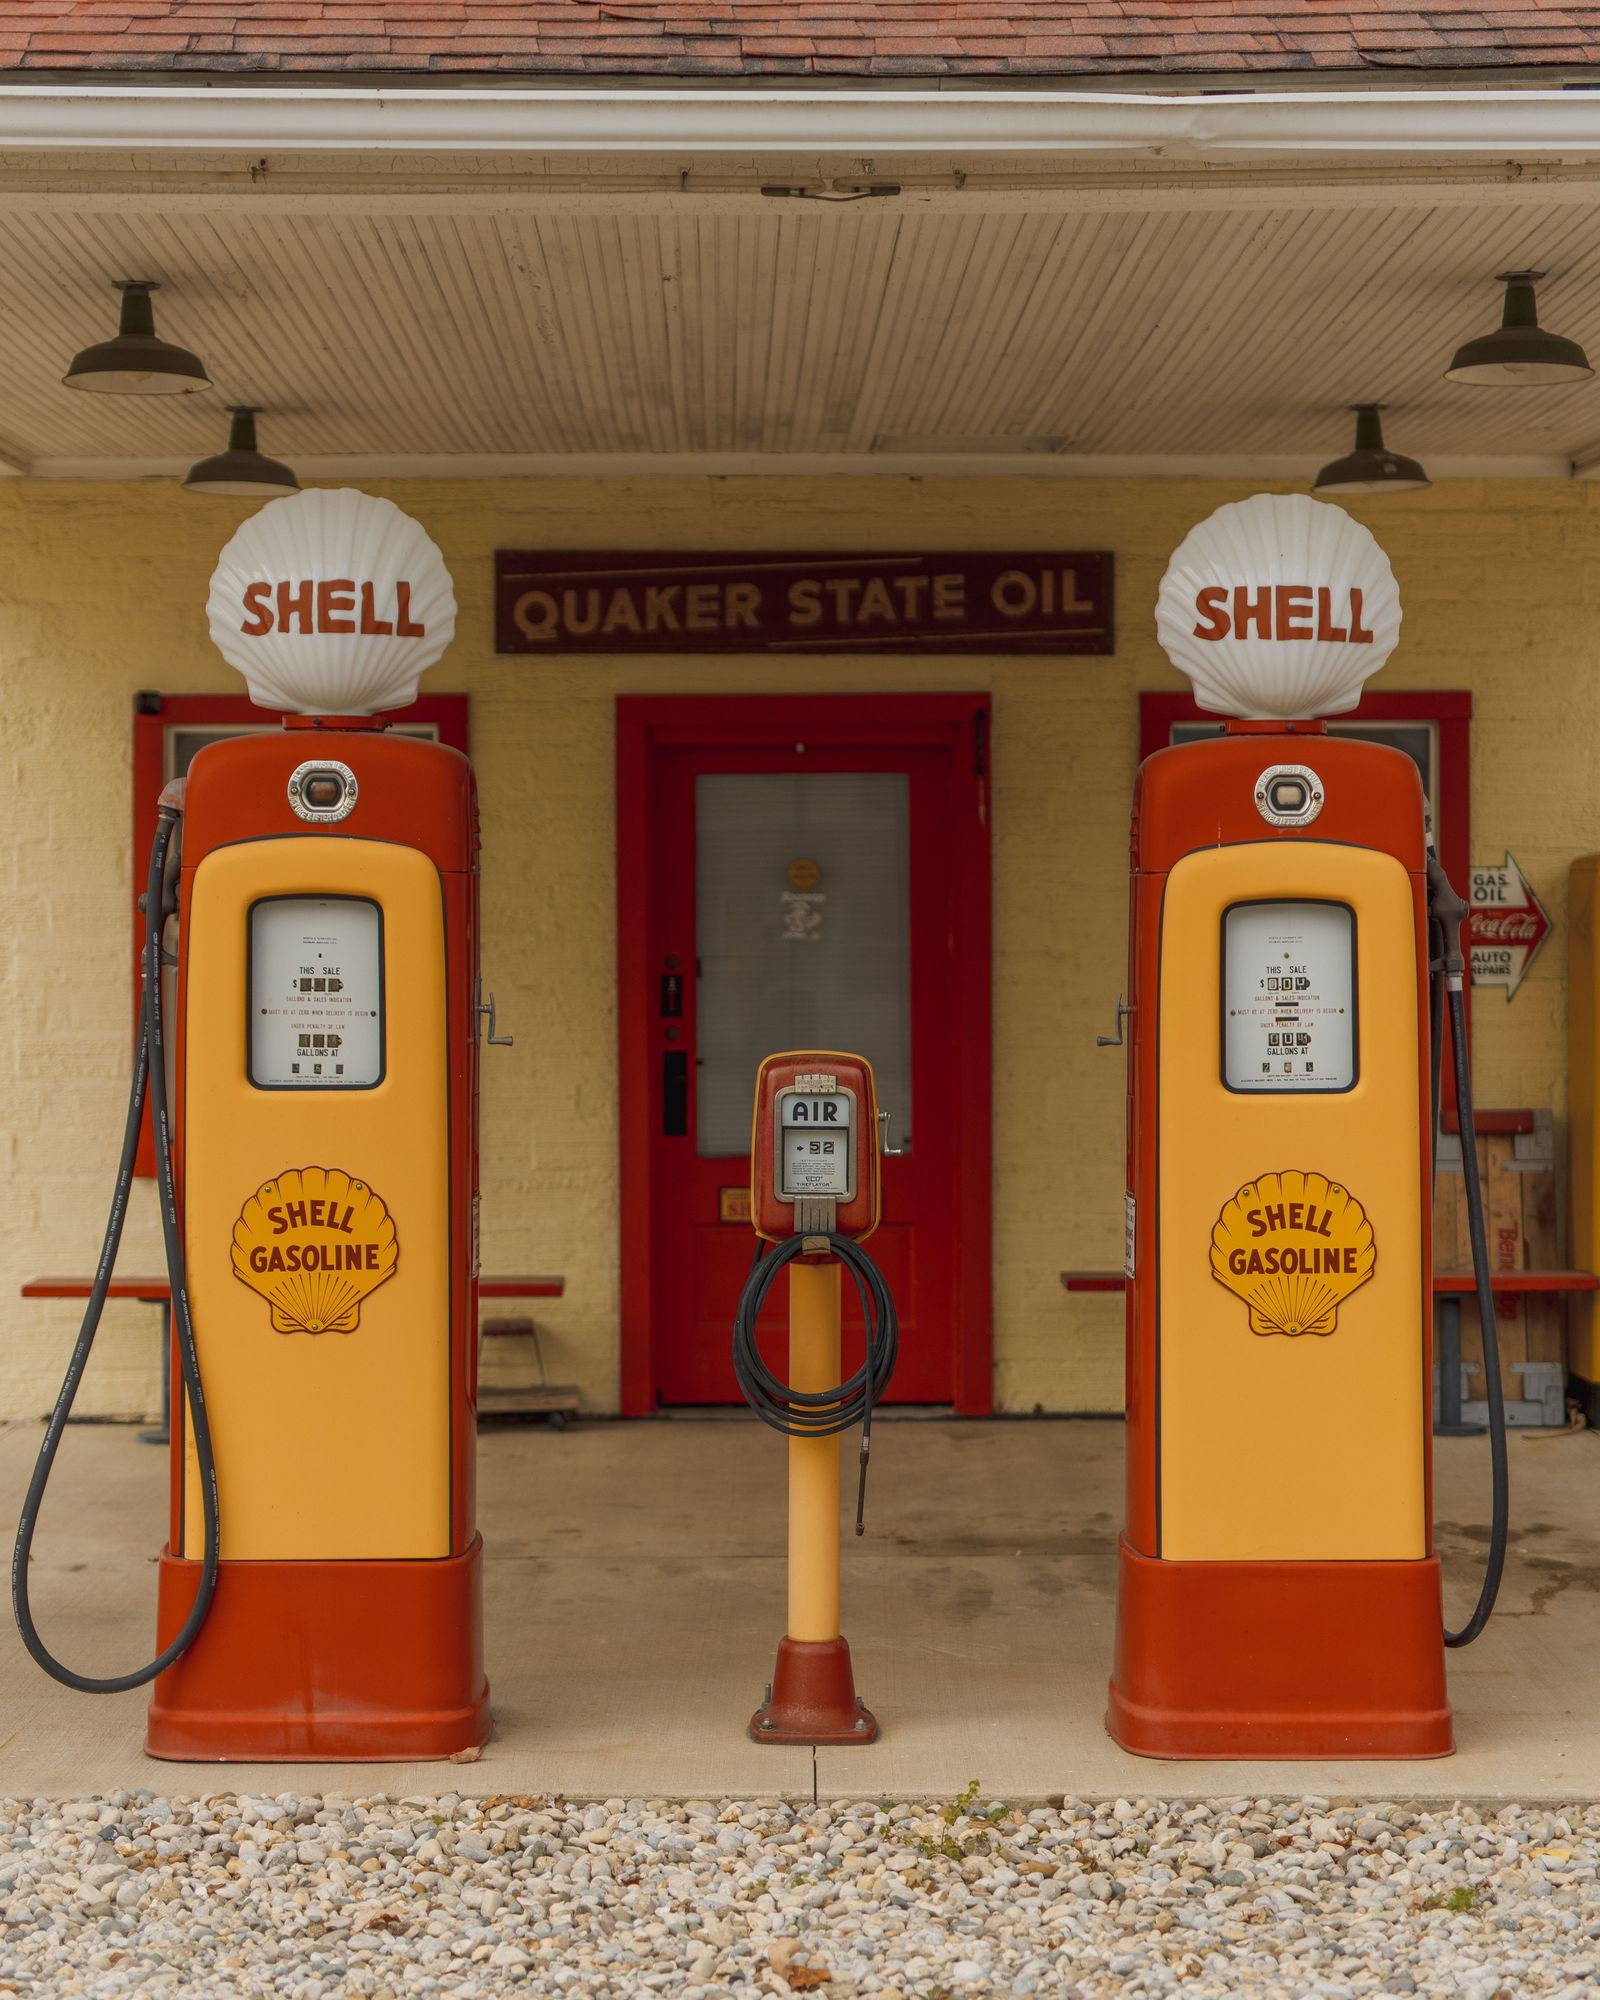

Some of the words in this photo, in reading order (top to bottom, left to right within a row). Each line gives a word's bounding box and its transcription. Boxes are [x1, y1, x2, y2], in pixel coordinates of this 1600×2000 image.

[242, 580, 425, 637] SHELL
[513, 581, 761, 639] QUAKER
[788, 573, 966, 626] STATE
[992, 568, 1094, 616] OIL
[1193, 586, 1373, 643] SHELL
[1473, 873, 1507, 886] GAS
[1473, 887, 1506, 902] OIL
[1472, 951, 1511, 963] AUTO
[300, 967, 315, 975] THIS
[322, 967, 341, 975] SALE
[1266, 966, 1281, 974] THIS
[1289, 965, 1307, 974] SALE
[1471, 965, 1511, 975] REPAIRS
[293, 979, 297, 988] $
[297, 1048, 329, 1057] GALLONS
[331, 1049, 339, 1057] AT
[1267, 1047, 1298, 1056] GALLONS
[1300, 1047, 1309, 1055] AT
[792, 1101, 838, 1122] AIR
[809, 1141, 834, 1154] 52
[268, 1200, 354, 1235] SHELL
[1247, 1203, 1332, 1238] SHELL
[250, 1244, 380, 1274] GASOLINE
[1229, 1248, 1358, 1275] GASOLINE
